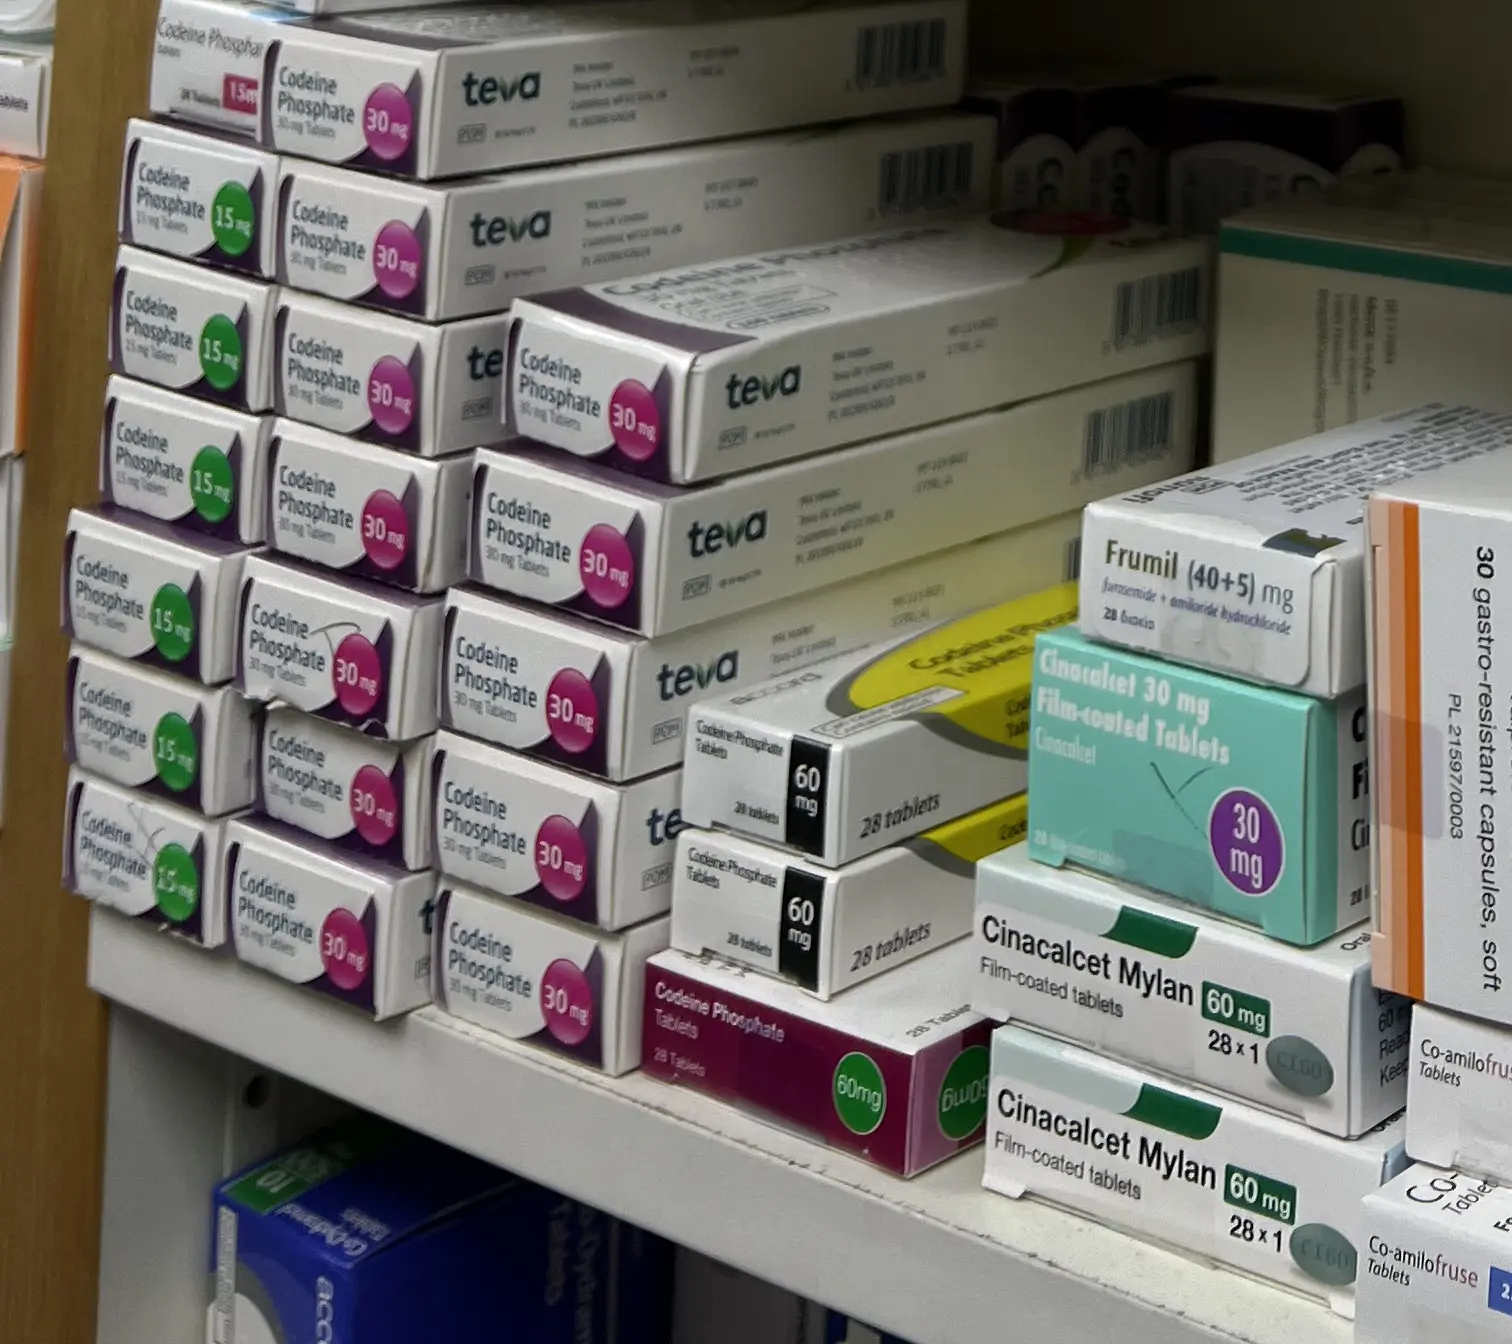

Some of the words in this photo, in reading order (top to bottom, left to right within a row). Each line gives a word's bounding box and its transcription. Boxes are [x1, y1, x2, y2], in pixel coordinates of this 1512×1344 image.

[519, 348, 581, 385] Codeine
[726, 365, 800, 410] teva
[519, 377, 601, 418] Phosphate
[611, 405, 636, 431] 30
[639, 421, 656, 442] mg
[1105, 538, 1179, 580] Frumil
[1187, 559, 1256, 605] (40+5)
[1262, 584, 1294, 614] mg
[1040, 648, 1136, 696] Cinacalcet
[1144, 677, 1170, 704] 30
[1176, 692, 1210, 724] mg
[1448, 693, 1461, 718] PL
[1036, 687, 1150, 742] Film-coated
[1156, 720, 1230, 764] Tablets
[1448, 724, 1463, 840] 21597/0003
[982, 914, 1111, 980] Cinacalcet
[1119, 958, 1194, 1006] Mylan
[1207, 989, 1234, 1018] 60
[1238, 1007, 1266, 1033] mg
[837, 1073, 882, 1110] 60mg
[1419, 1063, 1461, 1088] Tablets
